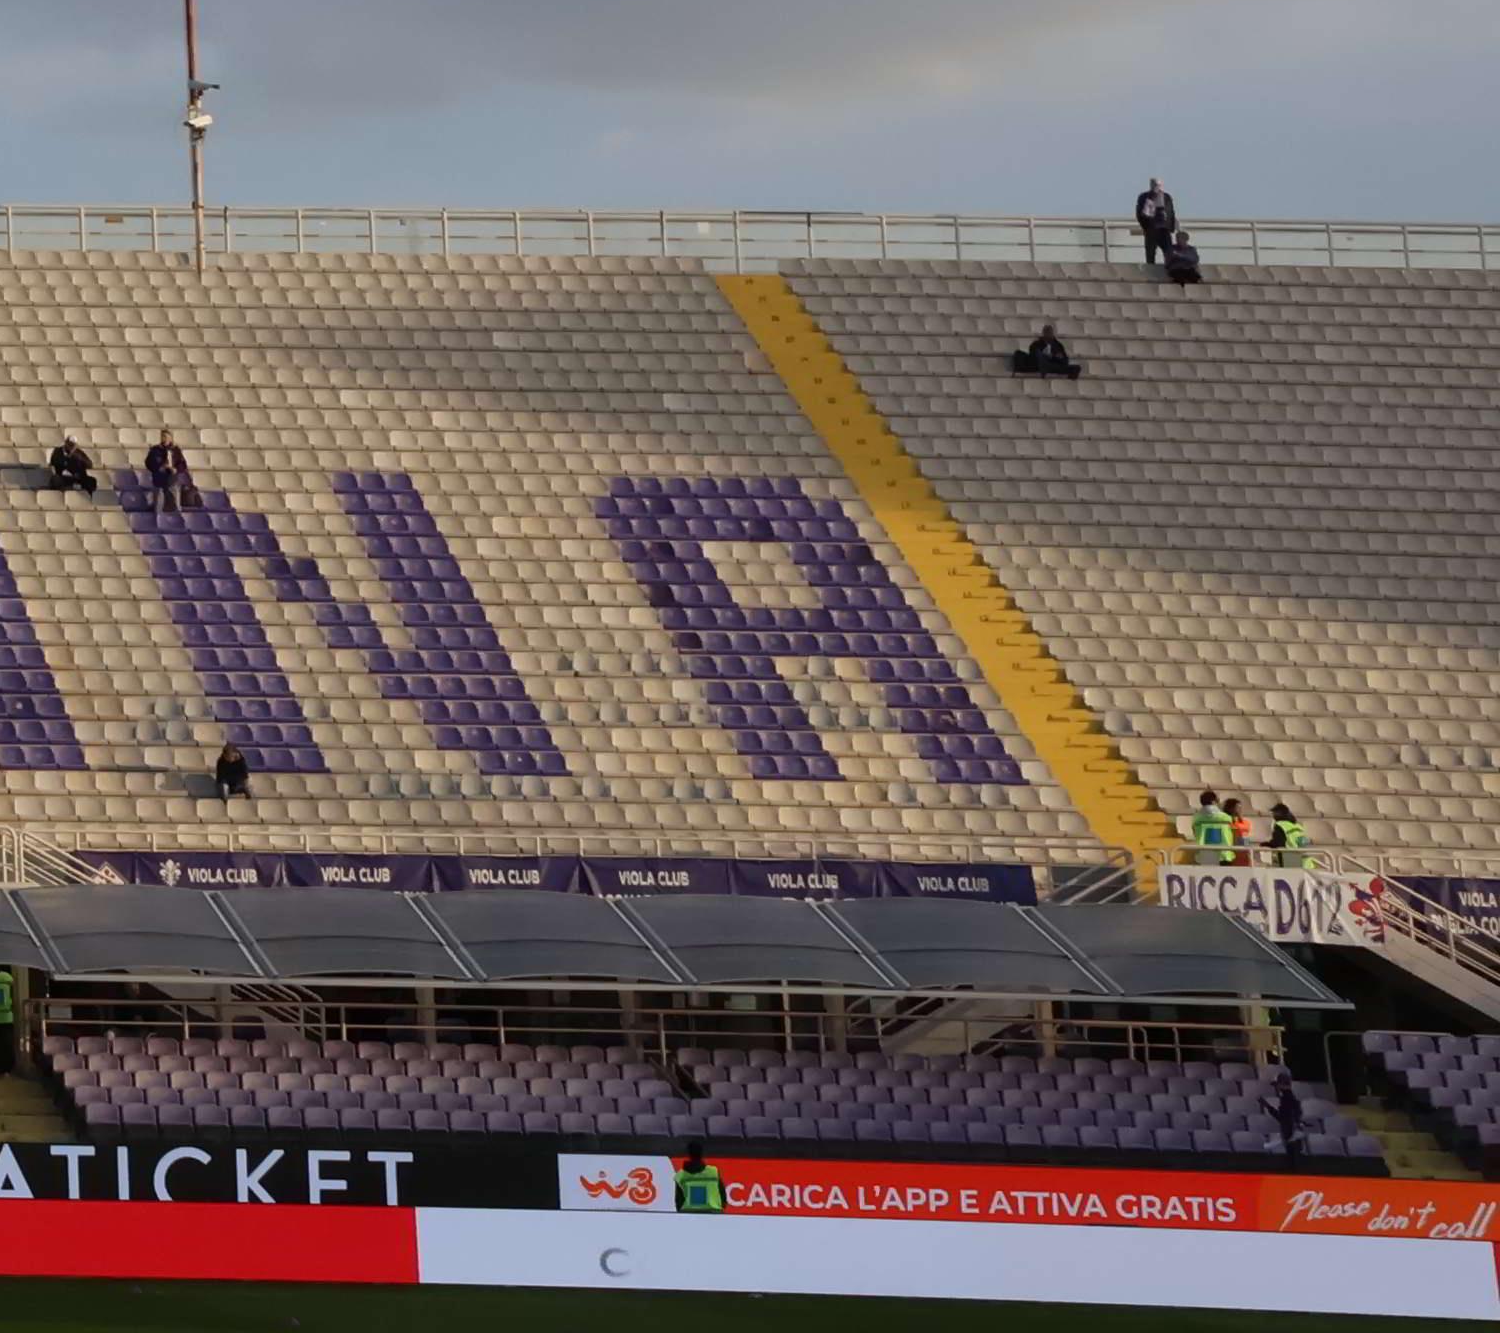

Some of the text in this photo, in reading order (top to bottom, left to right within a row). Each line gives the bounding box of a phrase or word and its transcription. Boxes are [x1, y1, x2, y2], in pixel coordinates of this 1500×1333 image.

[188, 867, 257, 884] VIOLA CLUB
[321, 866, 390, 882] VIOLA CLUB
[469, 868, 539, 884] VIOLA CLUB
[619, 870, 689, 886] VIOLA CLUB
[767, 873, 838, 889] VIOLA CLUB
[917, 876, 989, 892] VIOLA CLUB
[1458, 891, 1498, 907] VIOLA
[724, 1182, 1236, 1222] CARICA L'APP E ATTIVA GRATIS
[1279, 1190, 1497, 1239] Please don't call
